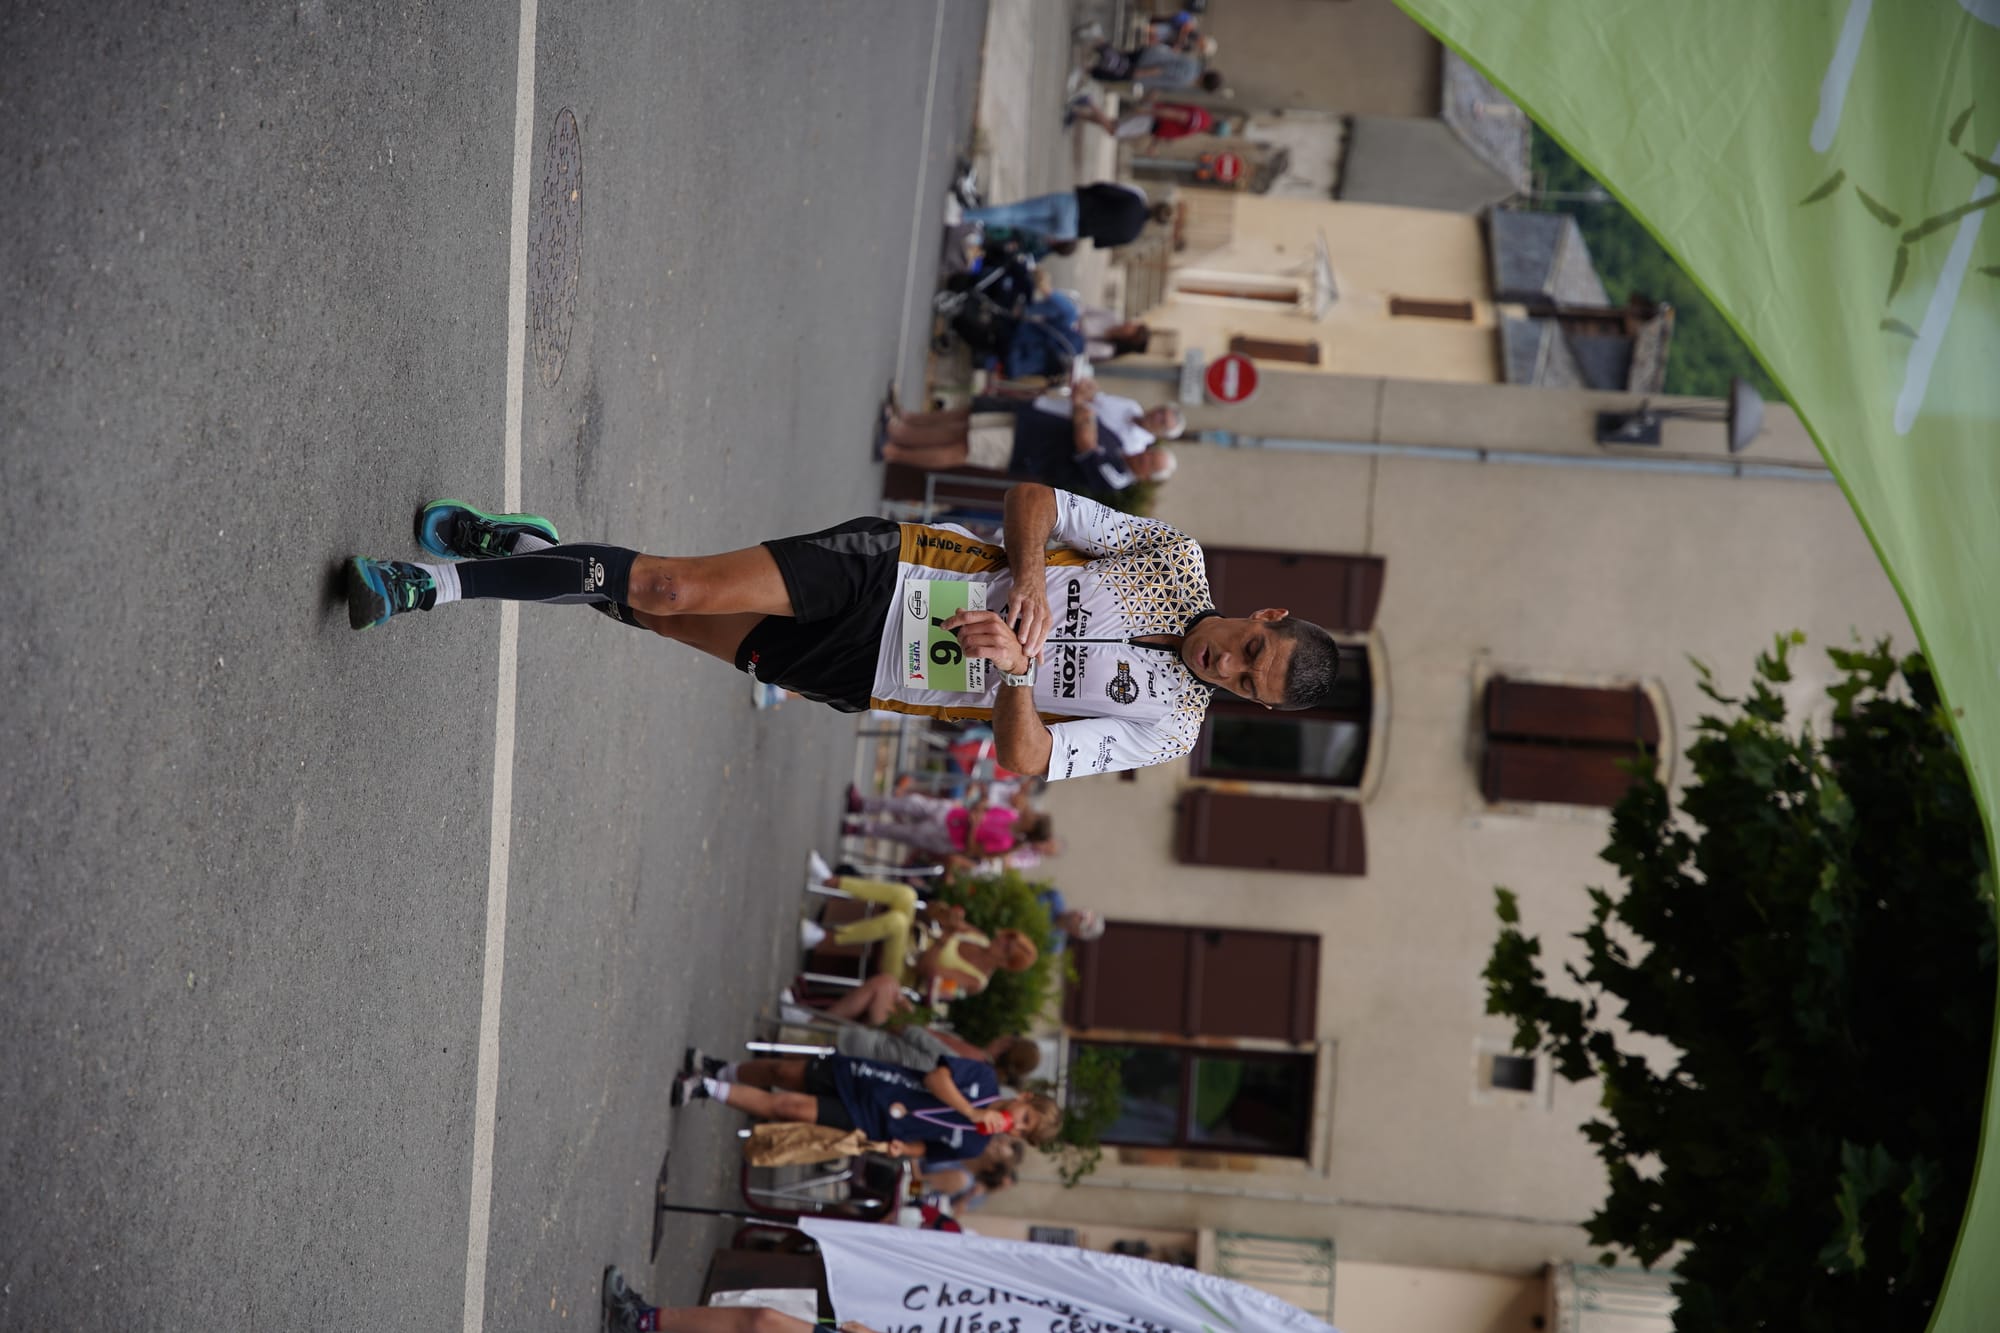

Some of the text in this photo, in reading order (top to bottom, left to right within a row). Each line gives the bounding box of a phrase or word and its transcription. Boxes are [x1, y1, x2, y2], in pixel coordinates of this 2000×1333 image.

[1054, 657, 1061, 667] et
[1063, 579, 1080, 698] GLEYZON
[1078, 604, 1092, 679] Jean Marc
